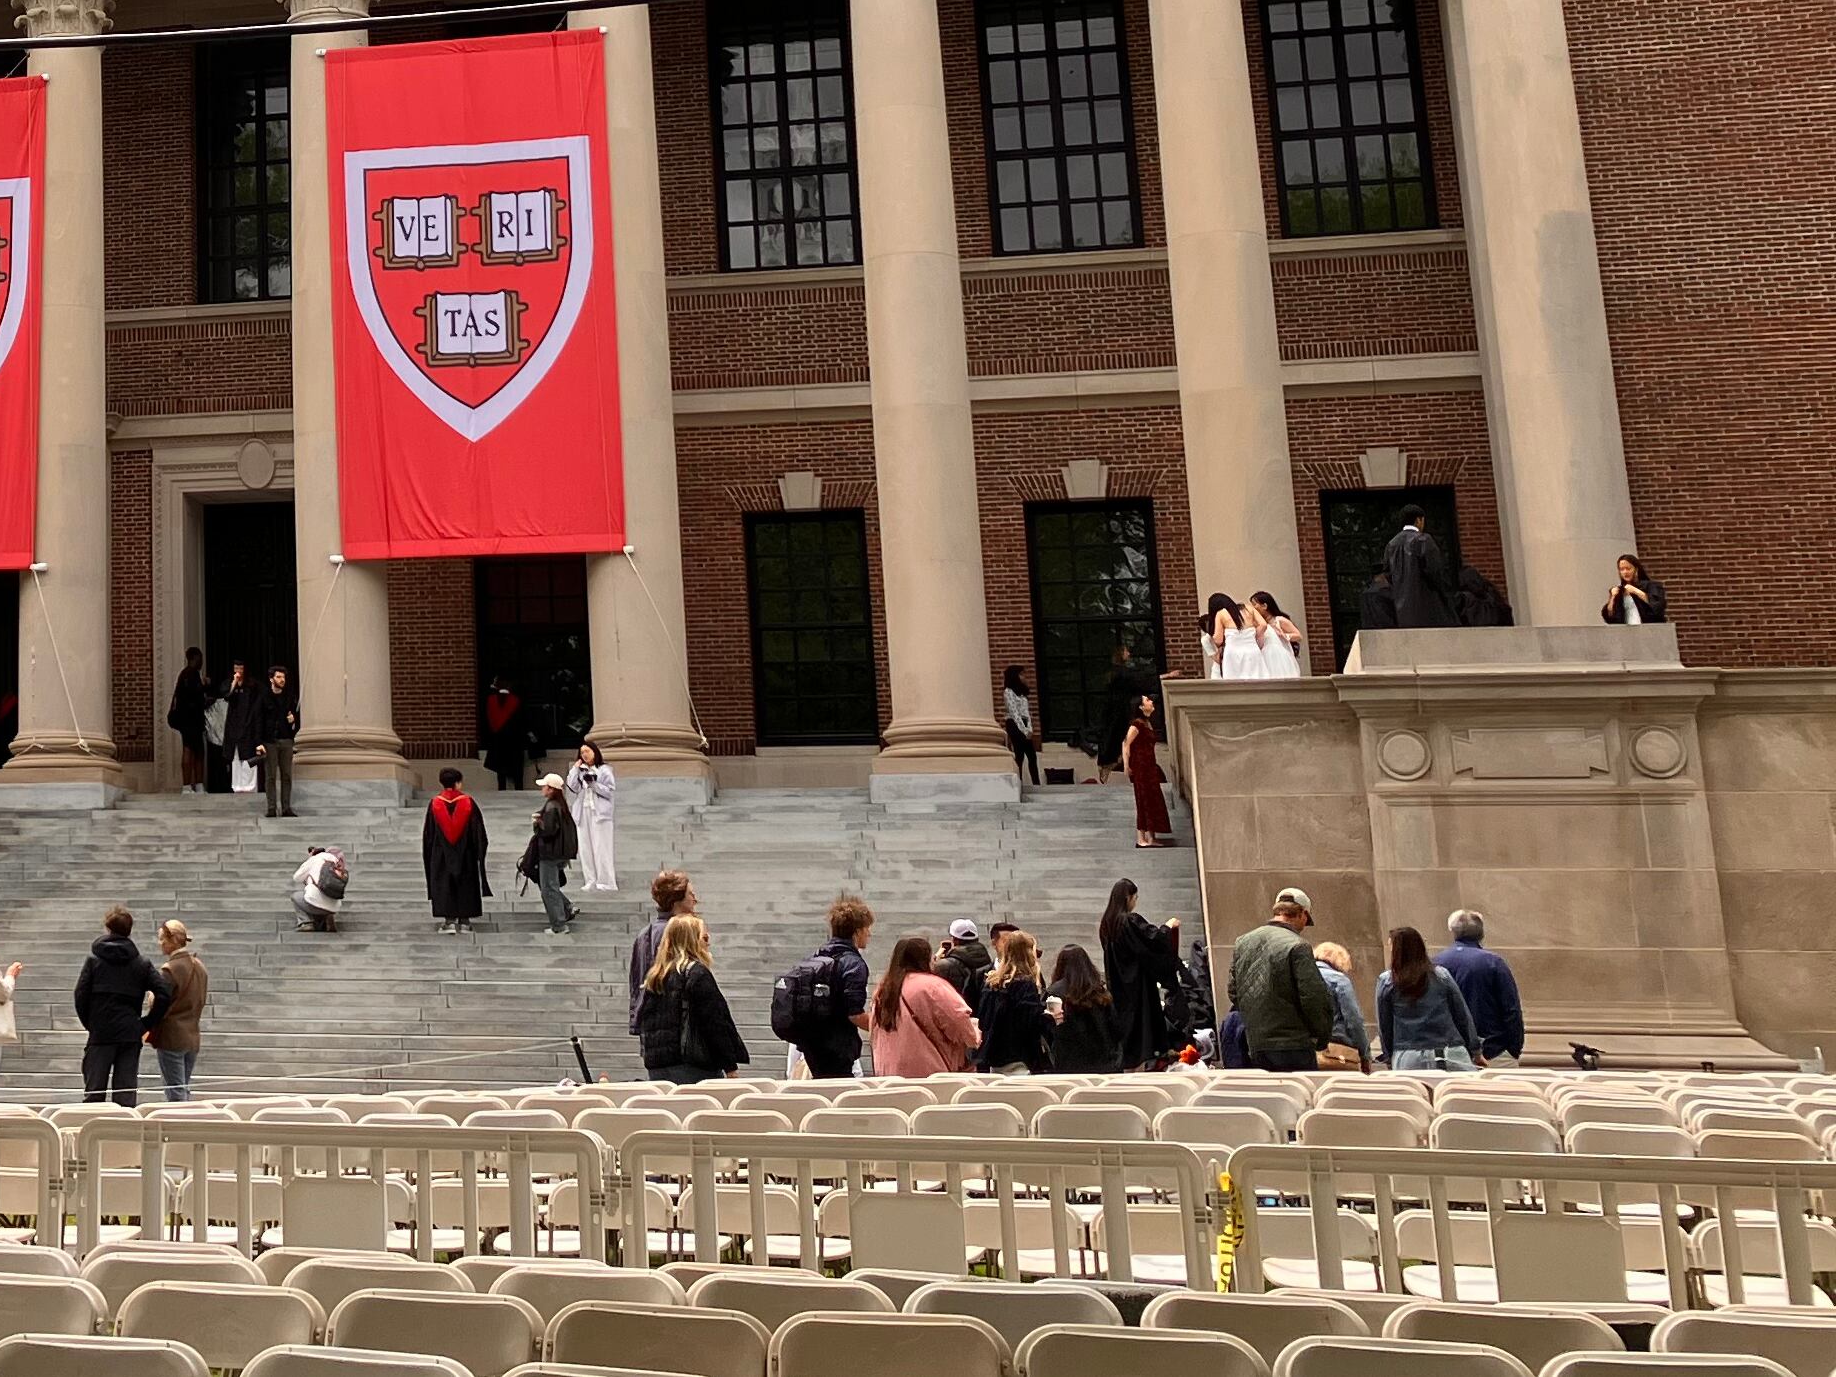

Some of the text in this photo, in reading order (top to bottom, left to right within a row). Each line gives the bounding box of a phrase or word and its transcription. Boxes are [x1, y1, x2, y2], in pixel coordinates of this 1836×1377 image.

[395, 208, 534, 242] VE RI
[443, 308, 501, 337] TAS
